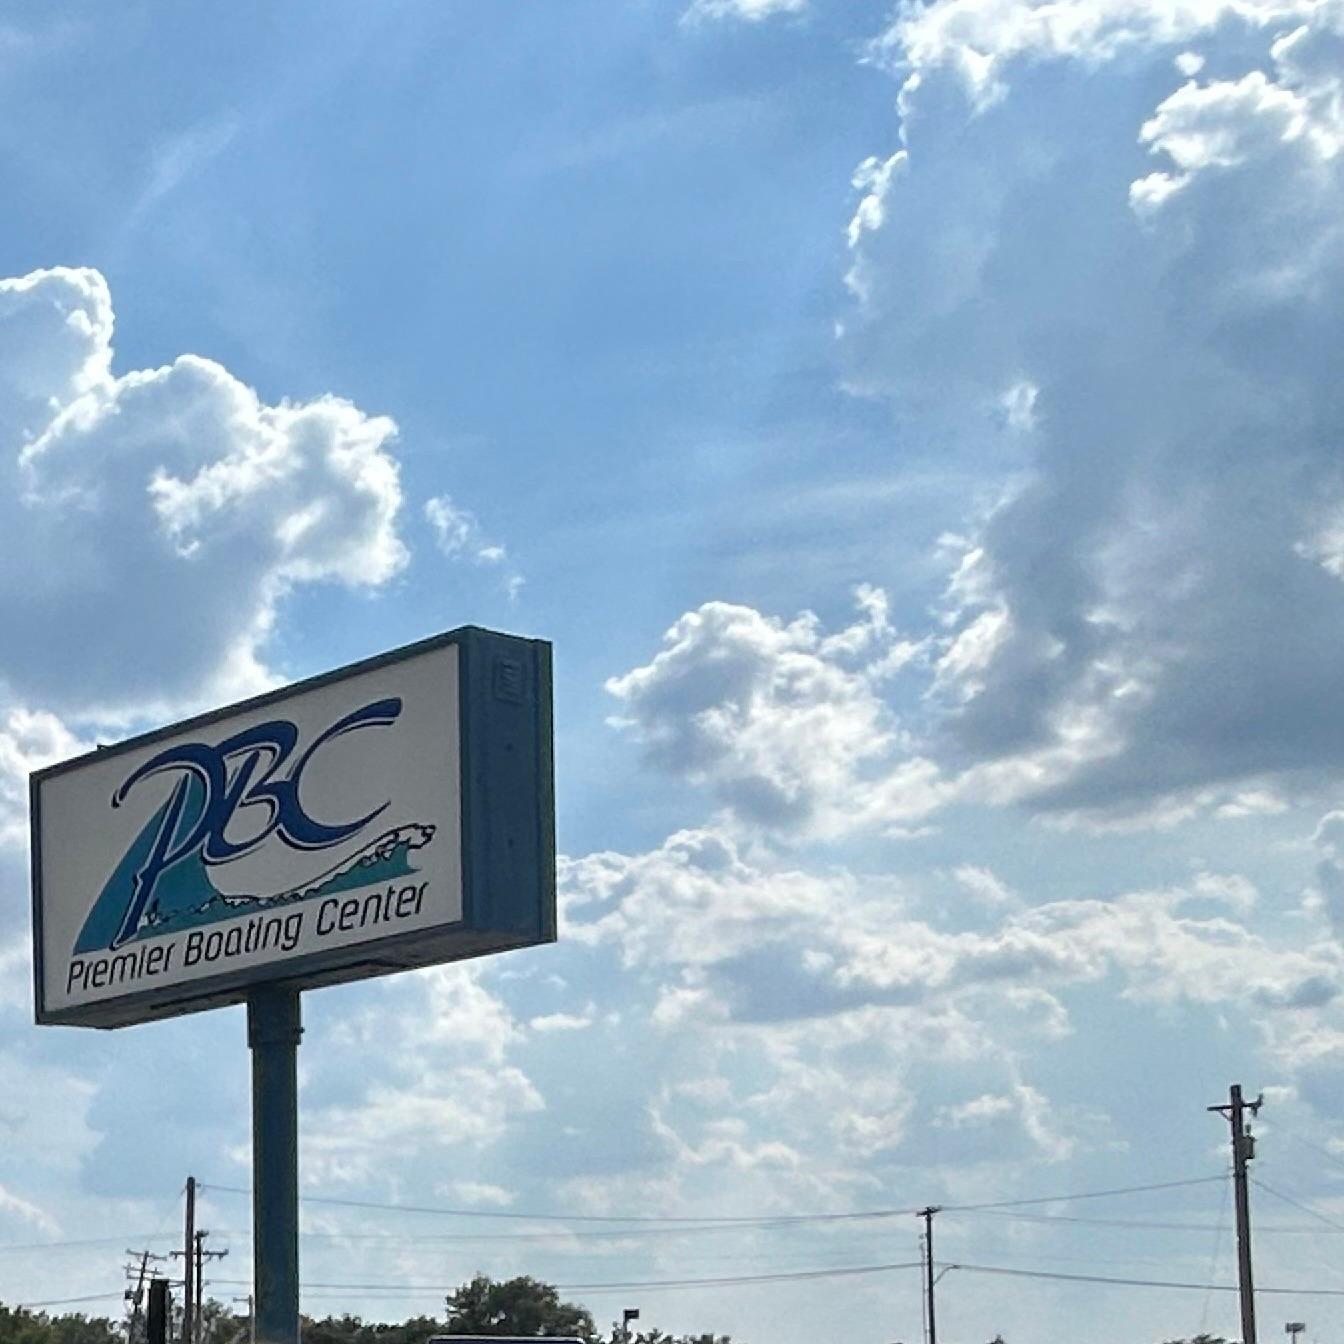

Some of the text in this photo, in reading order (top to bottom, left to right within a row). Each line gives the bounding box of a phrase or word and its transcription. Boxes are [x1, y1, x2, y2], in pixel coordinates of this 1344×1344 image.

[110, 696, 403, 953] PBC
[67, 881, 430, 994] Premier Boating Center
